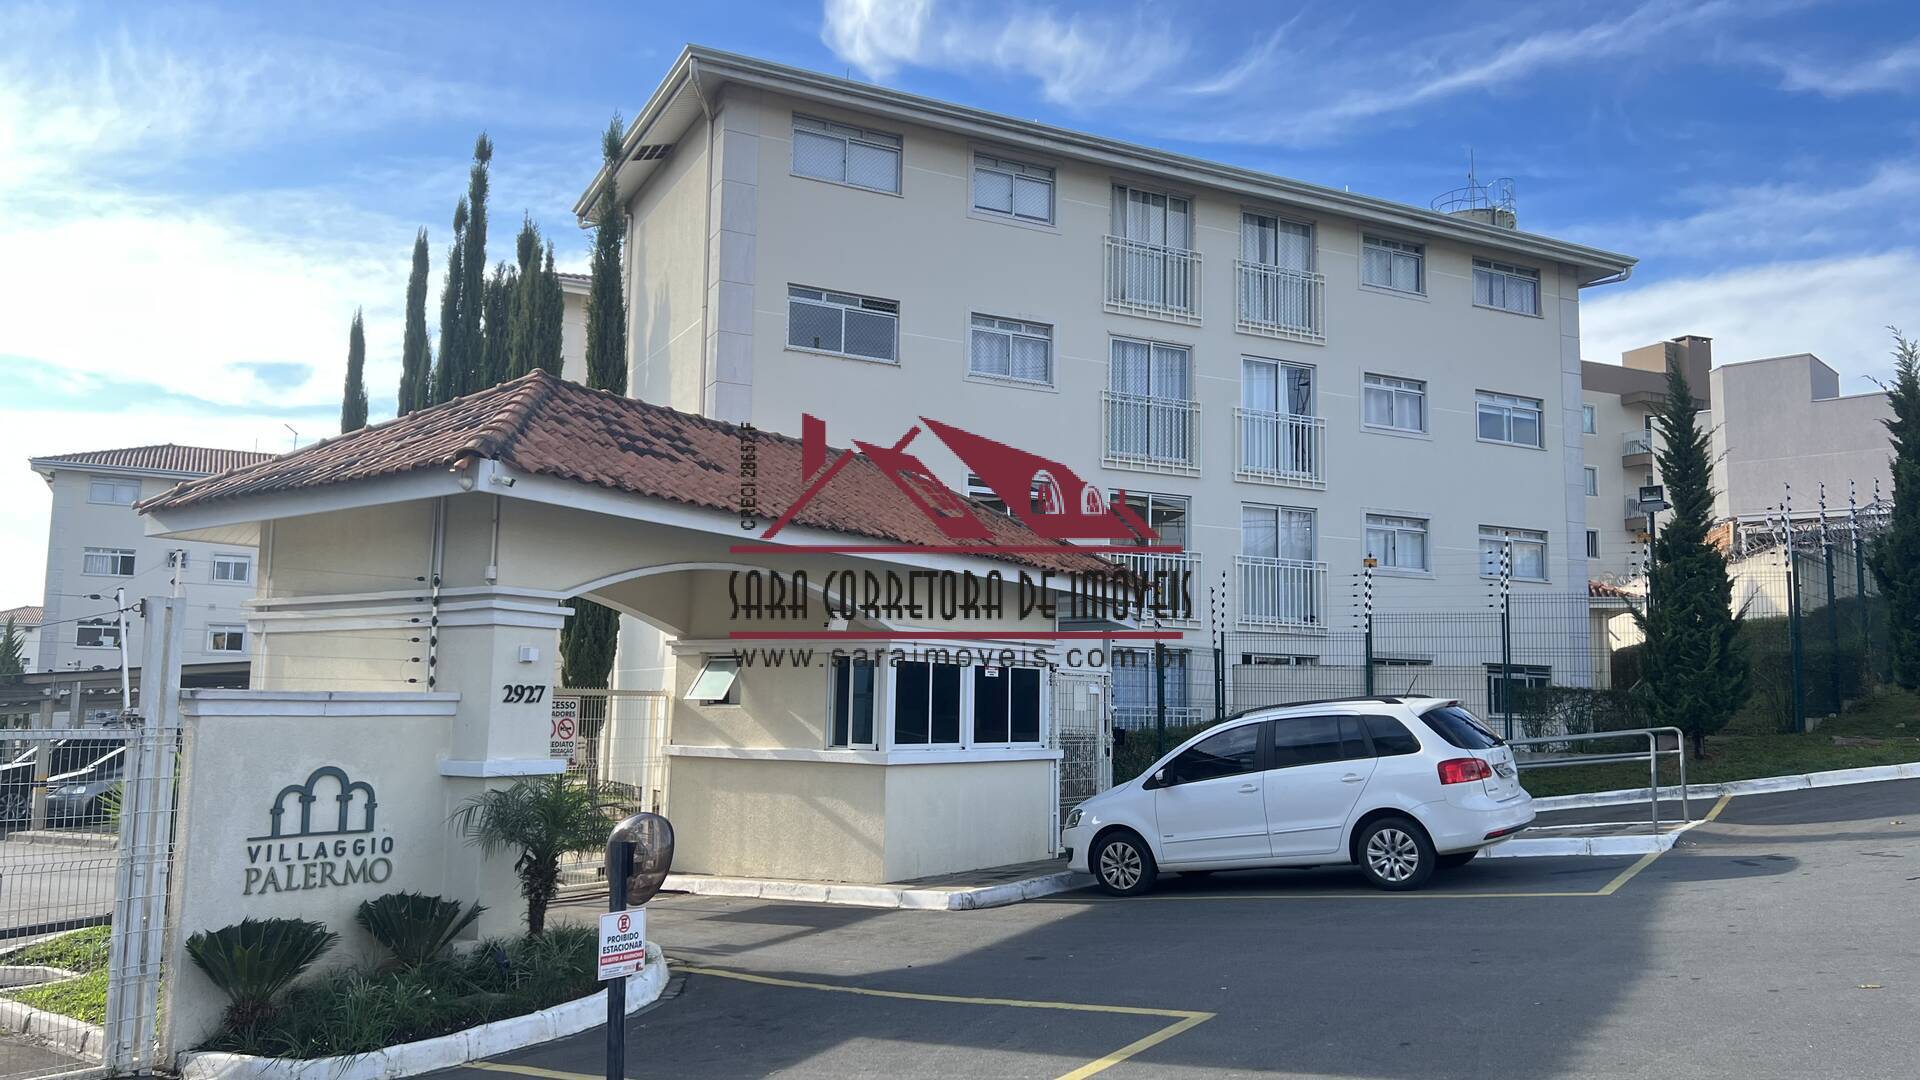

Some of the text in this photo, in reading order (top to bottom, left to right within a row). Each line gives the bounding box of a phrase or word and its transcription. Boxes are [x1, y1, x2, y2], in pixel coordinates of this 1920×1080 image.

[503, 684, 546, 704] 2927
[247, 836, 394, 864] VILLAGGIO
[243, 857, 393, 895] PALERMO
[603, 941, 642, 954] ESTACIONAR
[607, 932, 639, 943] PROIBIDO
